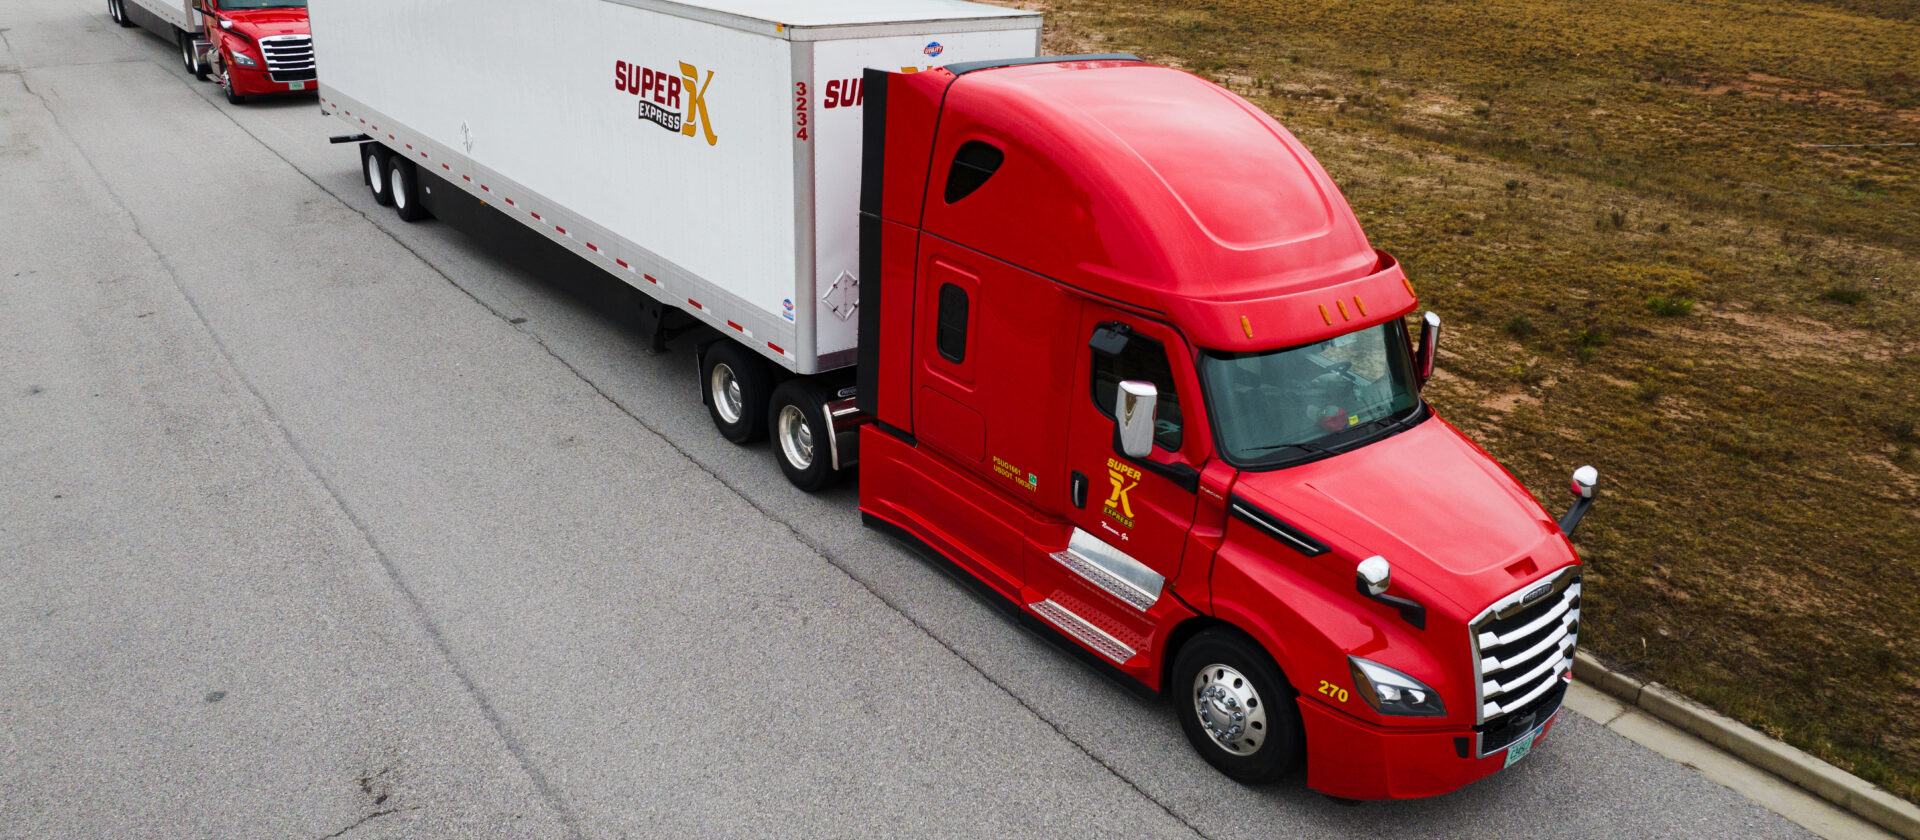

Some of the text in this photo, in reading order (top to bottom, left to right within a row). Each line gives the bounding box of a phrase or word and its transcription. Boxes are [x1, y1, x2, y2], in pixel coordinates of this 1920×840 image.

[615, 60, 718, 146] SUPER K
[796, 81, 808, 141] 3234
[639, 102, 681, 130] EXPRESS
[1107, 458, 1142, 481] SUPER
[1103, 506, 1134, 528] EXPRESS
[1318, 680, 1348, 702] 270
